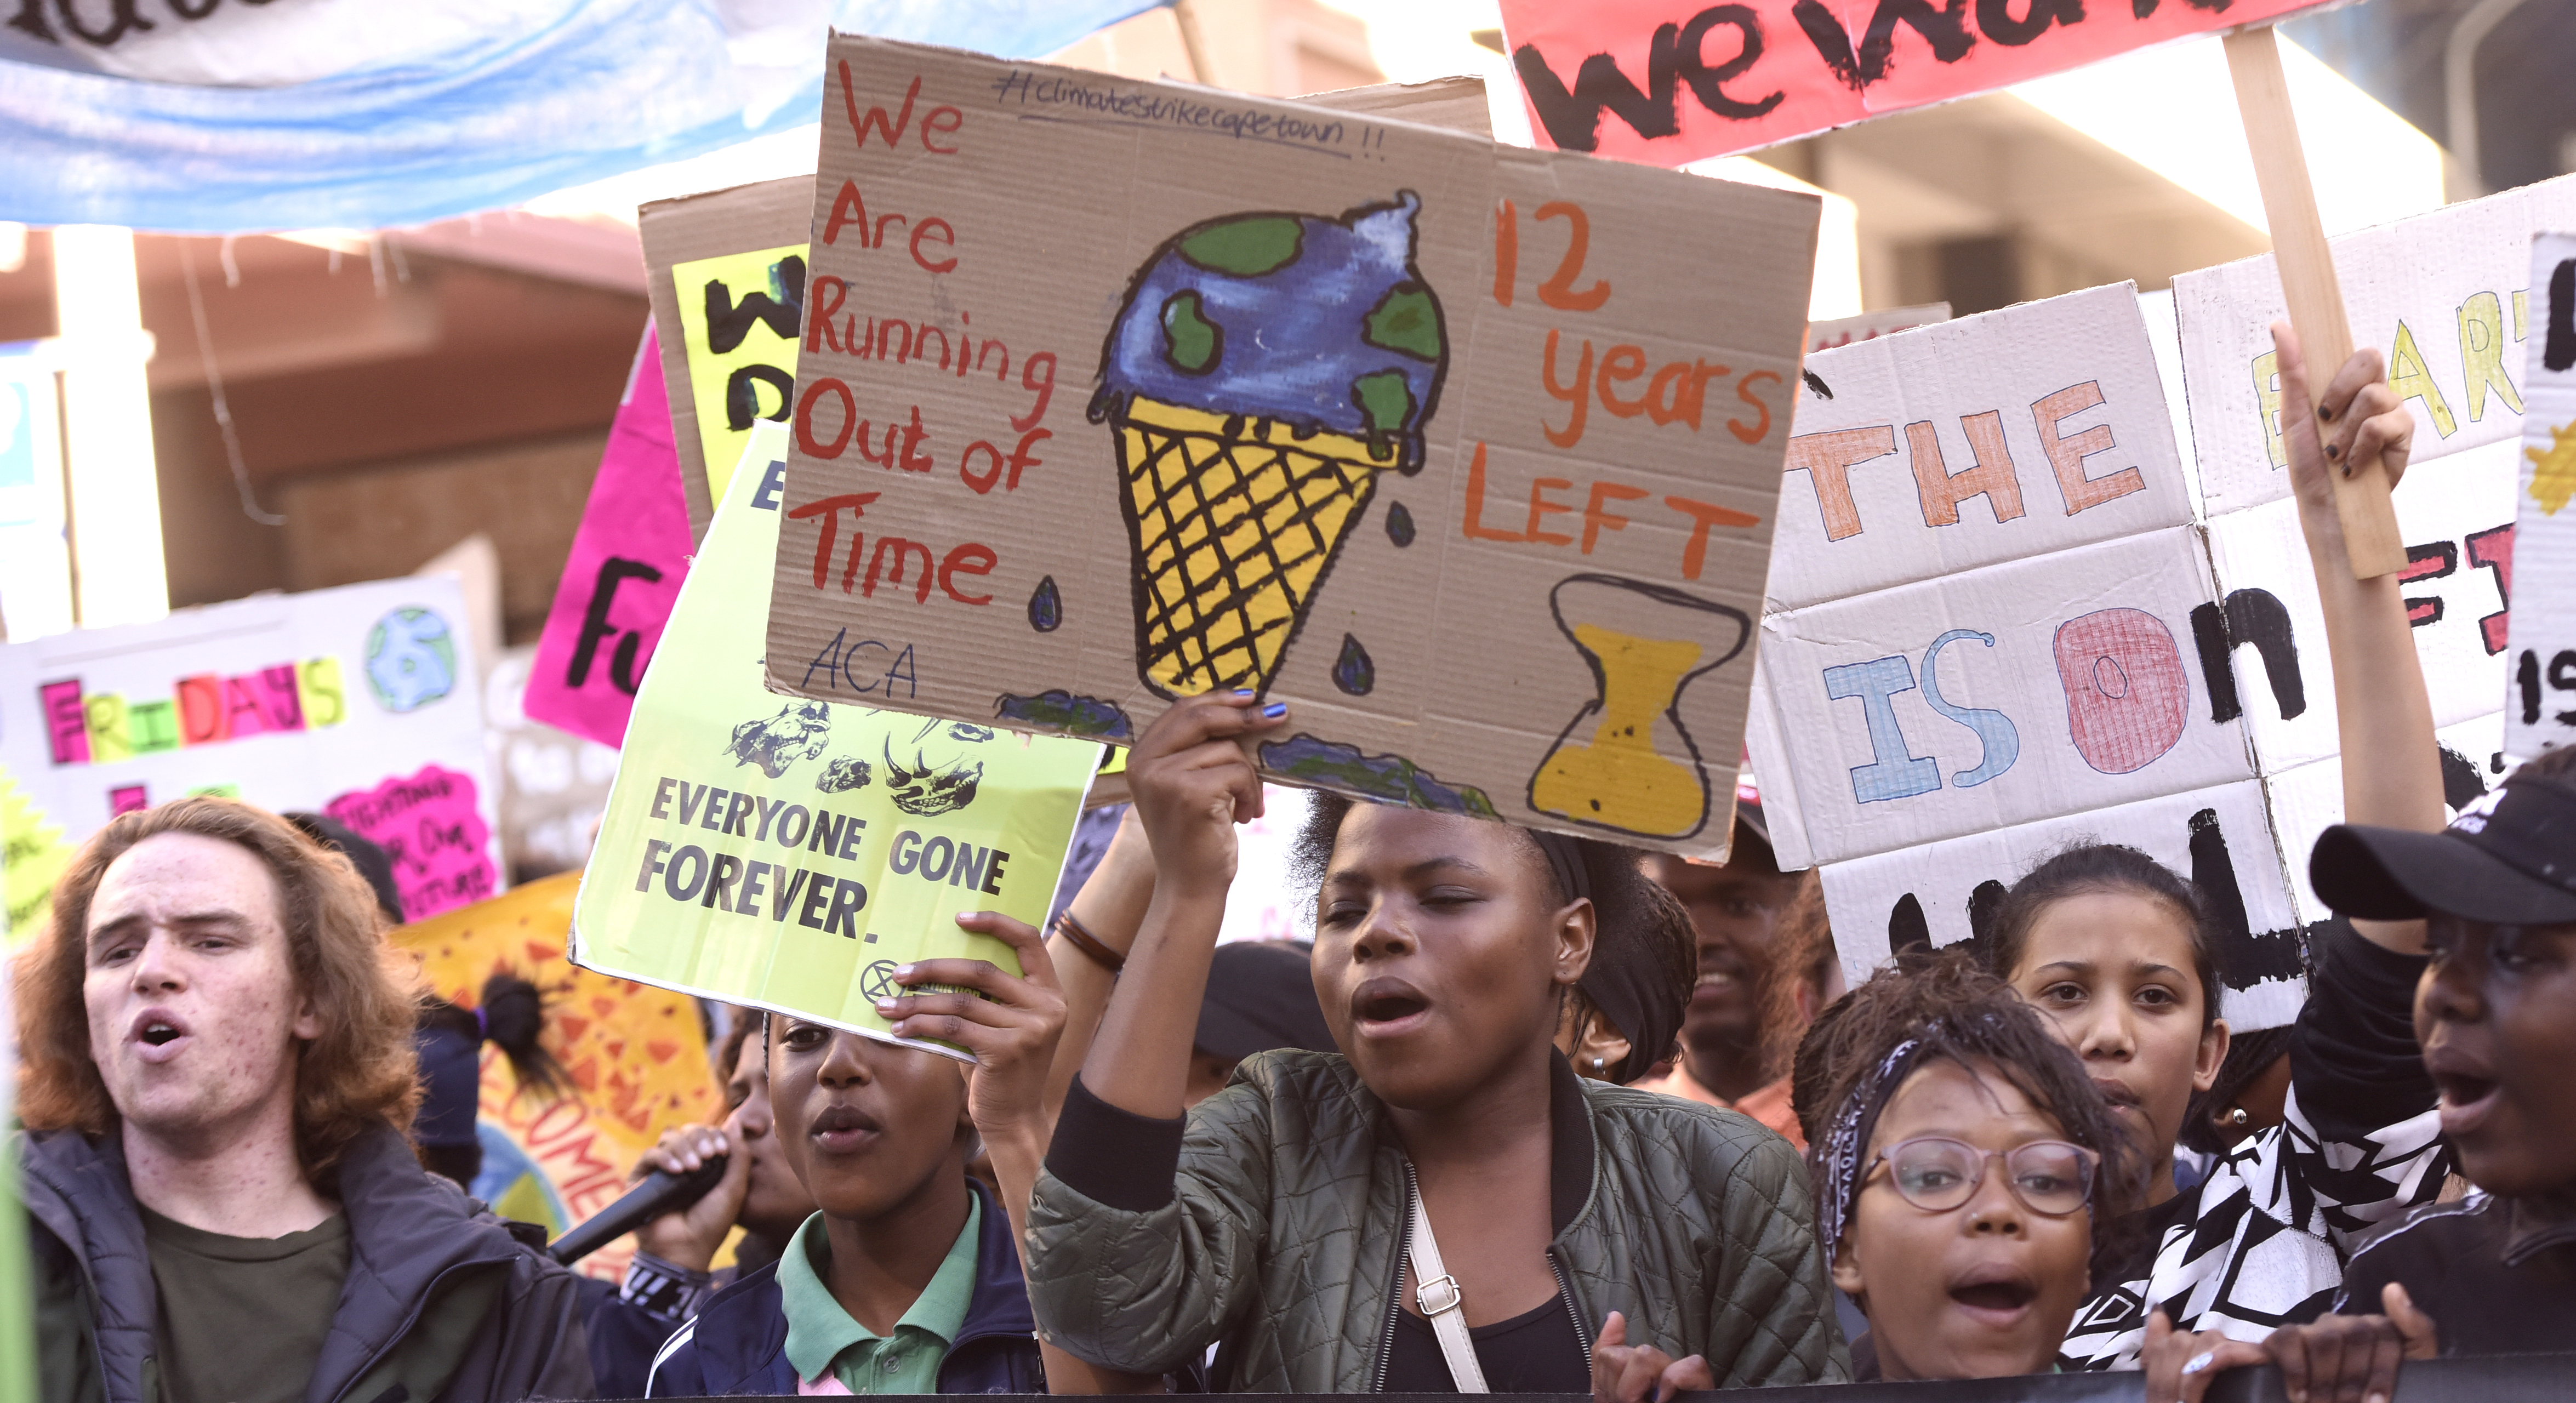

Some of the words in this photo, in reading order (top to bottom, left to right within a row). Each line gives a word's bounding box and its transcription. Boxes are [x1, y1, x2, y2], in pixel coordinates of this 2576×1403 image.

[838, 59, 962, 154] We
[823, 179, 958, 273] Are
[1493, 198, 1611, 312] 12
[806, 275, 1057, 432] Running
[1541, 329, 1782, 448] years
[795, 378, 933, 472] Out
[960, 428, 1053, 494] of
[1781, 380, 2146, 543] THE
[788, 491, 998, 605] Time
[1463, 441, 1761, 580] LEFT
[40, 657, 343, 766] FRIDAYS
[801, 626, 917, 699] ACA
[1822, 629, 2020, 805] IS
[635, 839, 878, 944] FOREVER.
[649, 776, 867, 863] EVERYONE
[889, 829, 1010, 897] GONE
